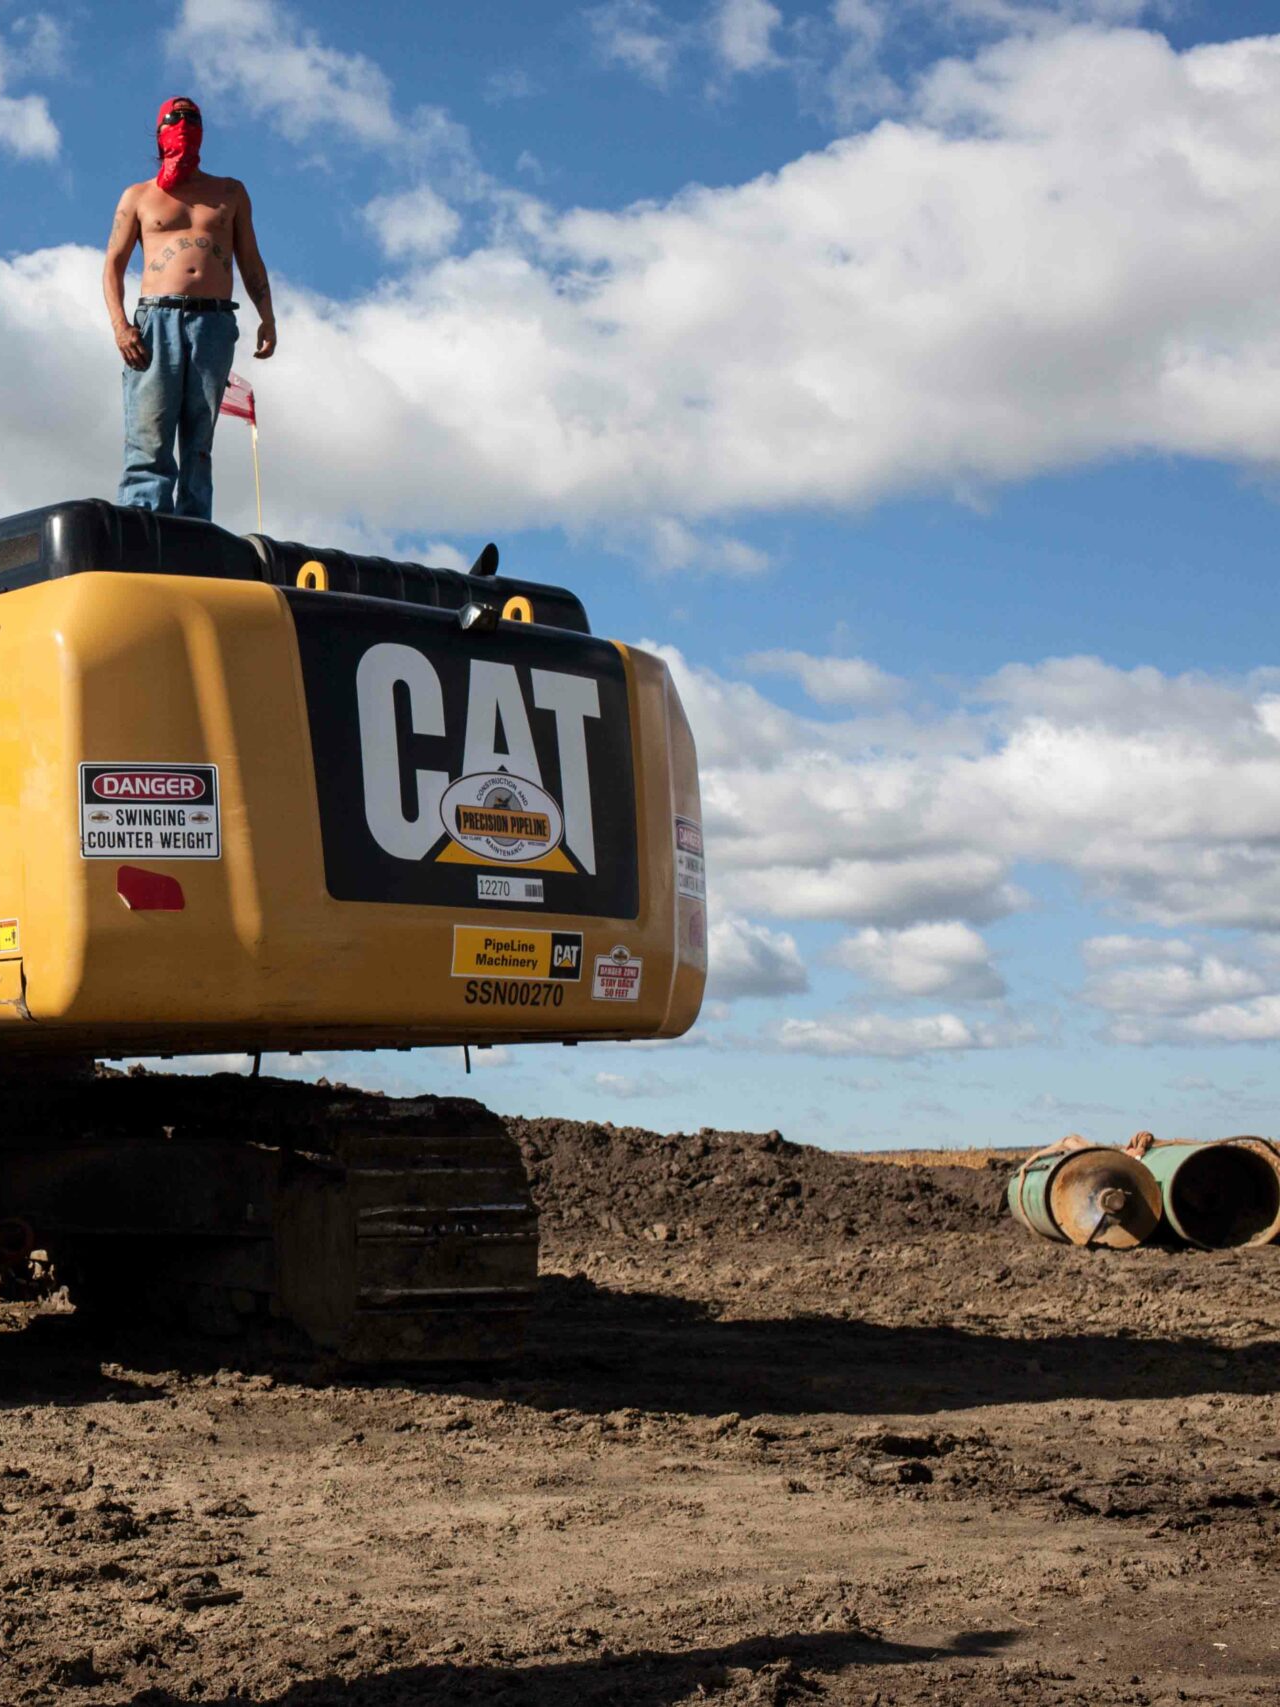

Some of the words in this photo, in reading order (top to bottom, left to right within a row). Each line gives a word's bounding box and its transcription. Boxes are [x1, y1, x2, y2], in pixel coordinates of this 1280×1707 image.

[355, 642, 601, 876] CAT
[103, 777, 195, 795] DANGER
[477, 777, 518, 801] CONSTRUCTION
[518, 790, 529, 807] AND
[116, 809, 186, 826] SWINGING
[462, 811, 508, 833] PRECISION
[510, 816, 548, 837] PIPELINE
[88, 831, 153, 849] COUNTER
[160, 832, 213, 849] WEIGHT
[486, 838, 525, 857] MAINTENANCE
[479, 880, 510, 896] 12270
[484, 938, 535, 953] PipeLine
[475, 953, 538, 970] Machinery
[553, 944, 580, 968] CAT
[600, 978, 616, 987] STAY
[464, 980, 564, 1007] SSN00270
